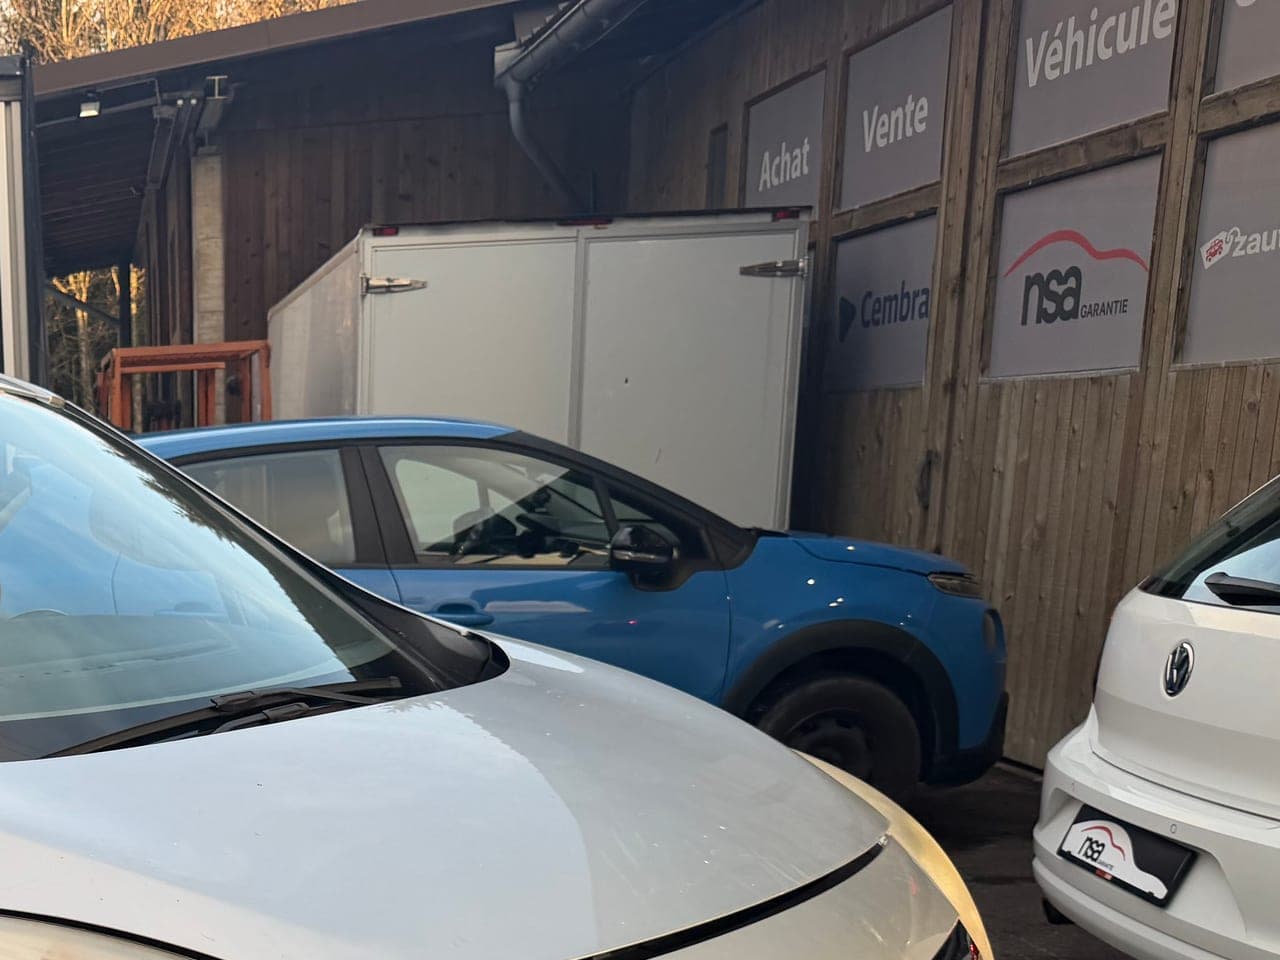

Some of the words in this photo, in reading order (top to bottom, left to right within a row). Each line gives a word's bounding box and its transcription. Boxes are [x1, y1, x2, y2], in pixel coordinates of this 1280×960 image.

[1026, 0, 1175, 87] Véhicule
[863, 94, 928, 152] Vente
[758, 137, 809, 191] Achat
[1232, 229, 1280, 257] zau
[861, 280, 929, 328] Cembra
[1021, 266, 1082, 325] nsa
[1080, 299, 1128, 318] GARANTIE
[1078, 837, 1105, 861] nsa
